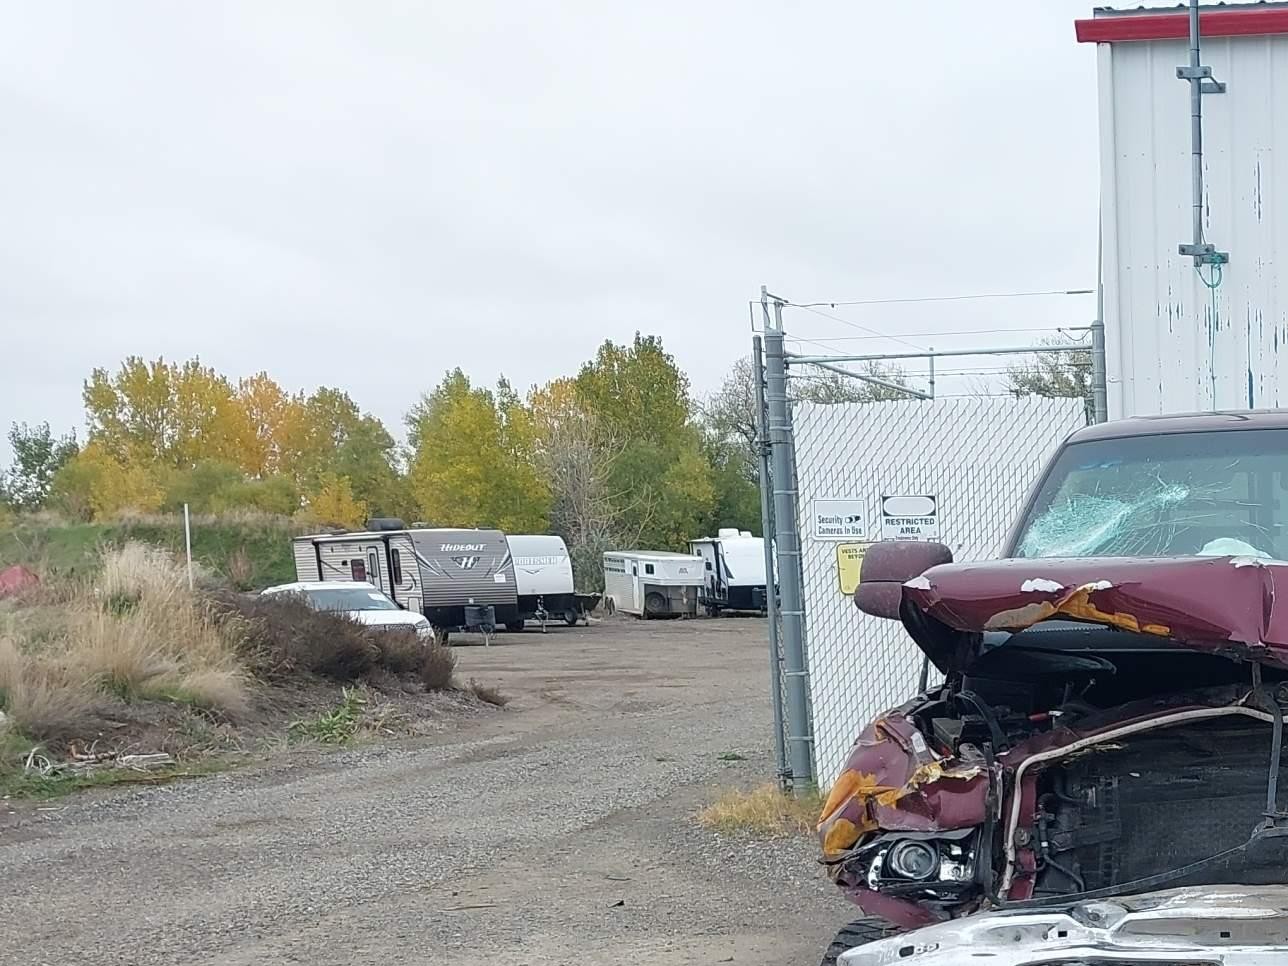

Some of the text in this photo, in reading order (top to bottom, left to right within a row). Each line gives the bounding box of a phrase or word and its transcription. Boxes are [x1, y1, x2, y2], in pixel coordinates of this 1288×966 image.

[818, 515, 843, 526] Security
[885, 518, 935, 526] RESTRICTED
[818, 526, 862, 535] Cameras In Use
[440, 543, 487, 552] HIDEOUT
